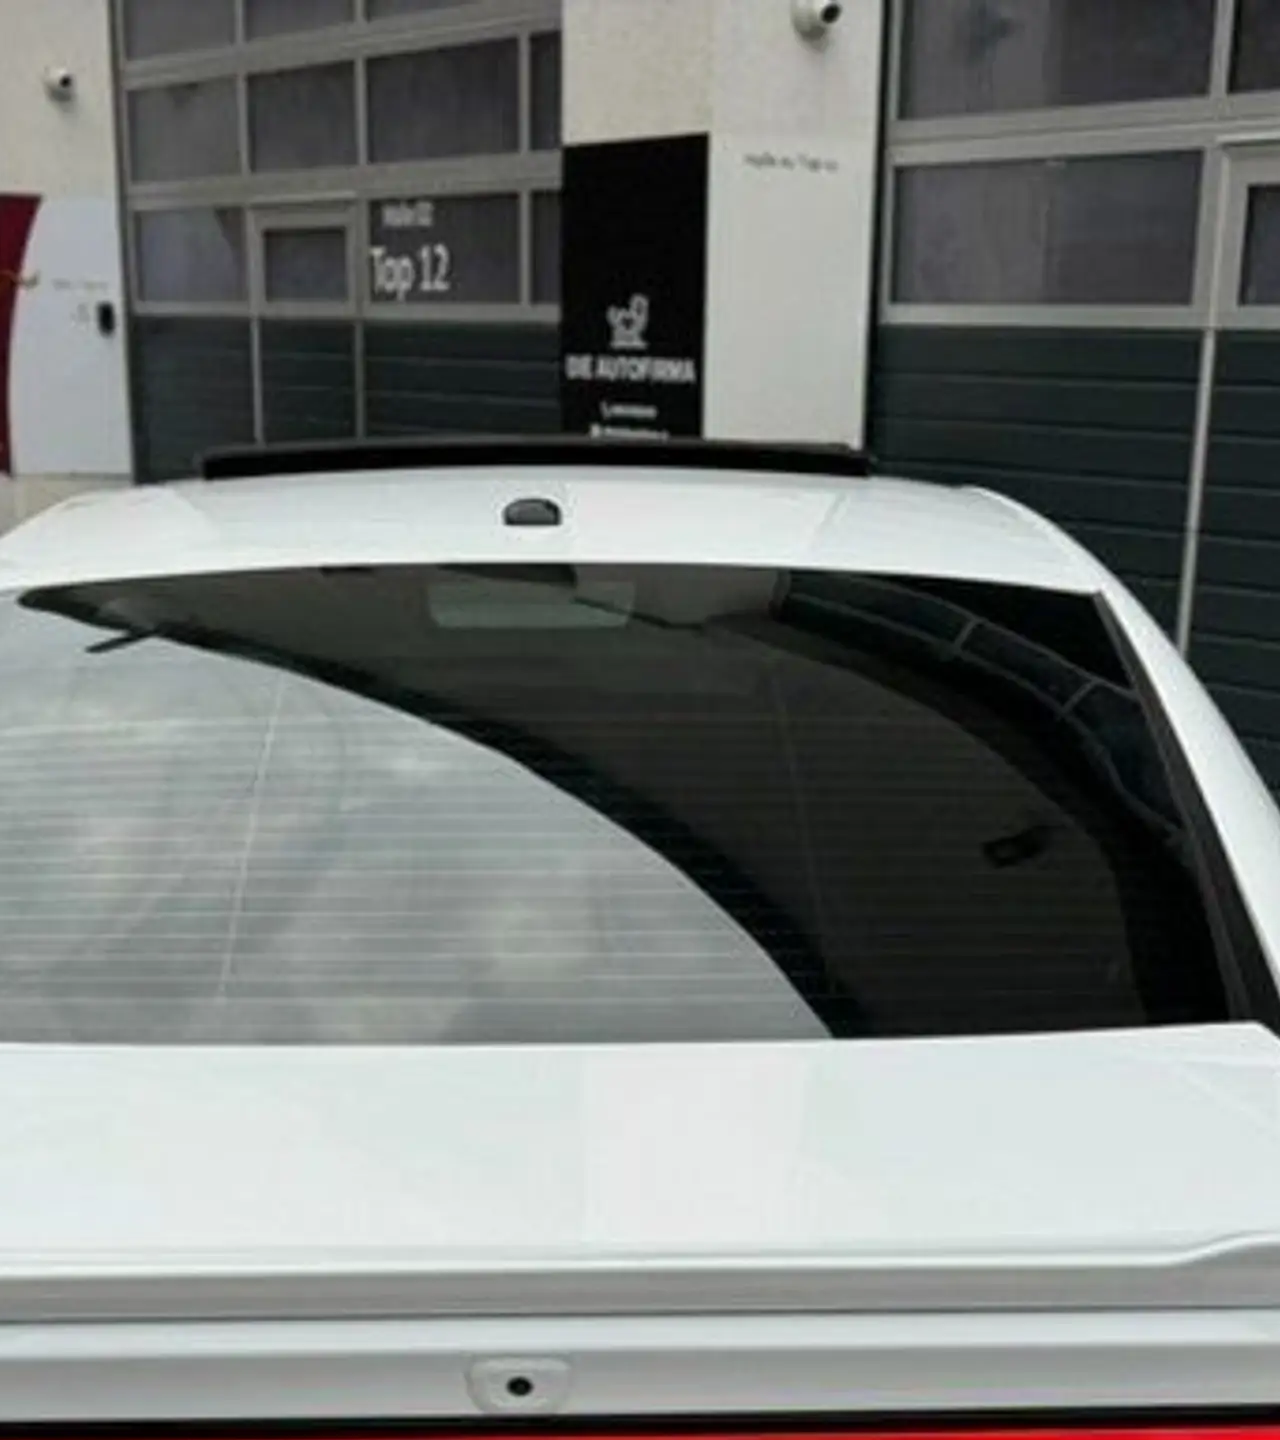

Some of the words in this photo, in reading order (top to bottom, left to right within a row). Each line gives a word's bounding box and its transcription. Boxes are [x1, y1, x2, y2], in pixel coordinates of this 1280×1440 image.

[370, 246, 415, 302] Top
[419, 243, 450, 292] 12
[596, 354, 696, 384] AUTOFIRMA
